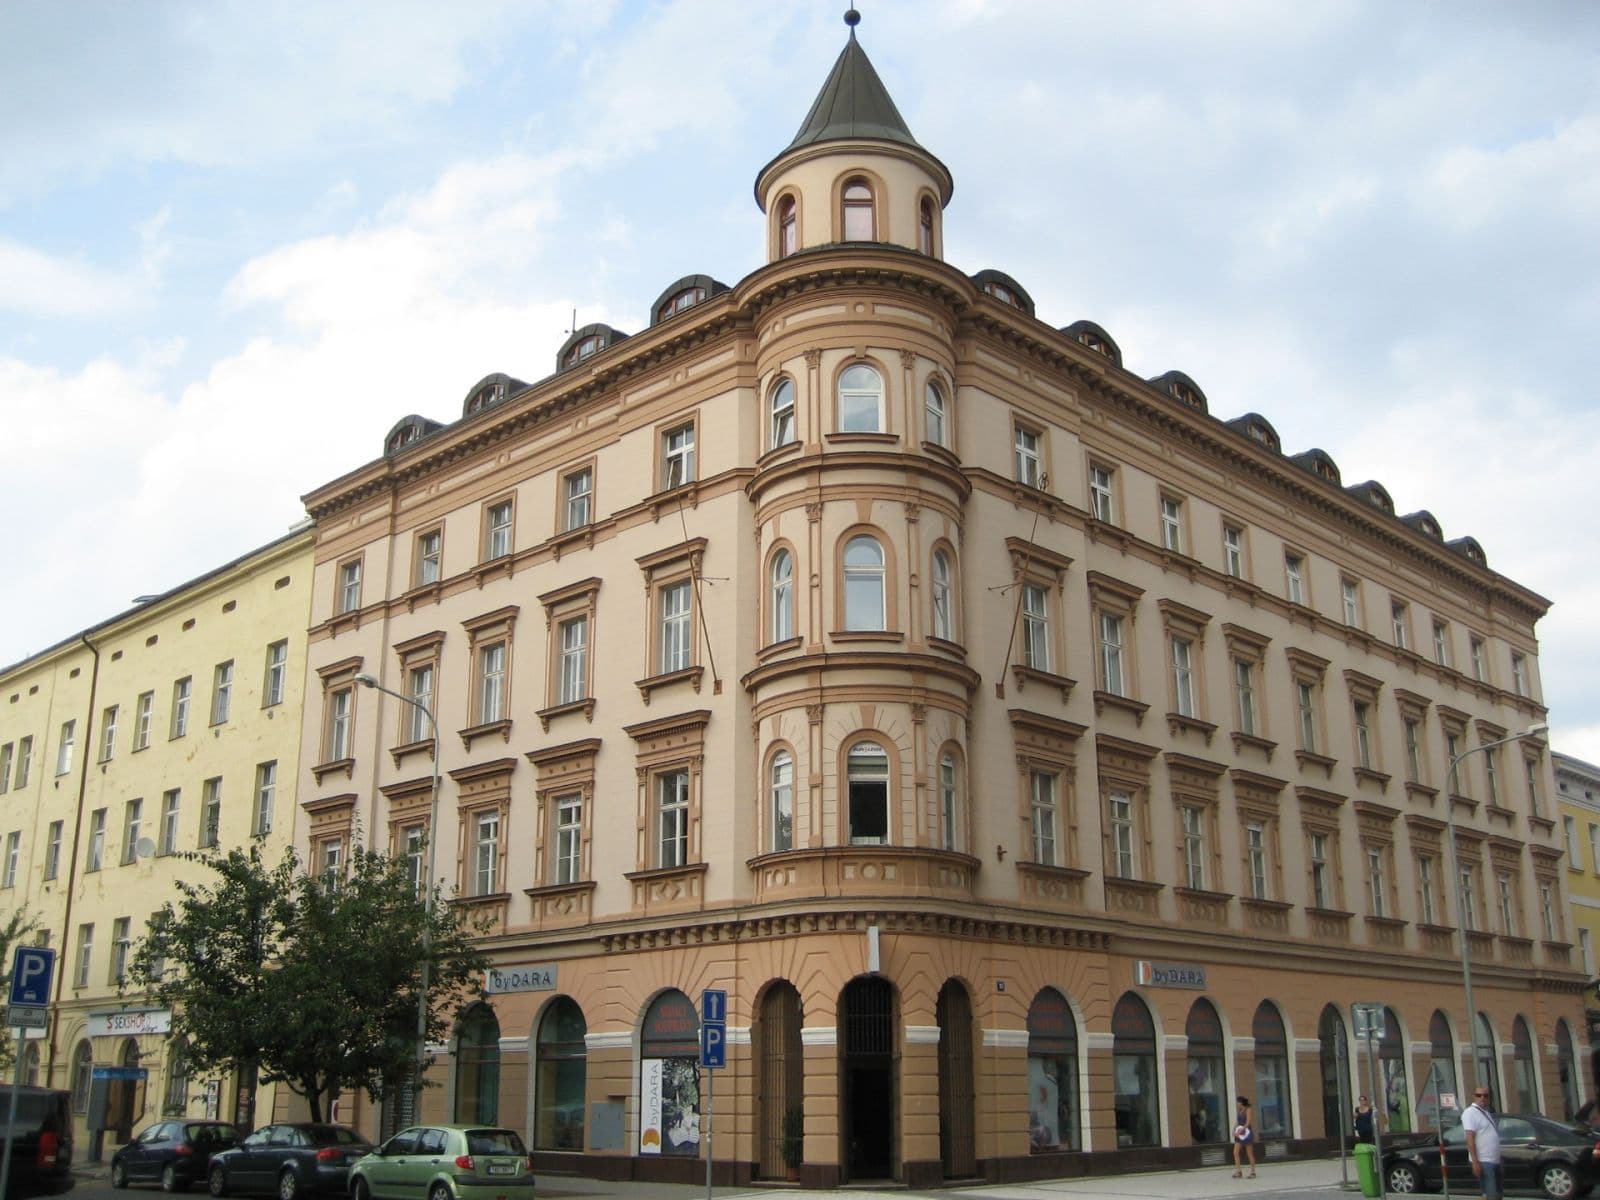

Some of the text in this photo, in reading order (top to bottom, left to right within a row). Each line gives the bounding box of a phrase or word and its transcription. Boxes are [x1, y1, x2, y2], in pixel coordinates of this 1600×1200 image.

[21, 954, 45, 987] P
[1152, 968, 1204, 985] byDARA
[706, 1028, 720, 1054] P
[648, 1063, 659, 1126] byDARA
